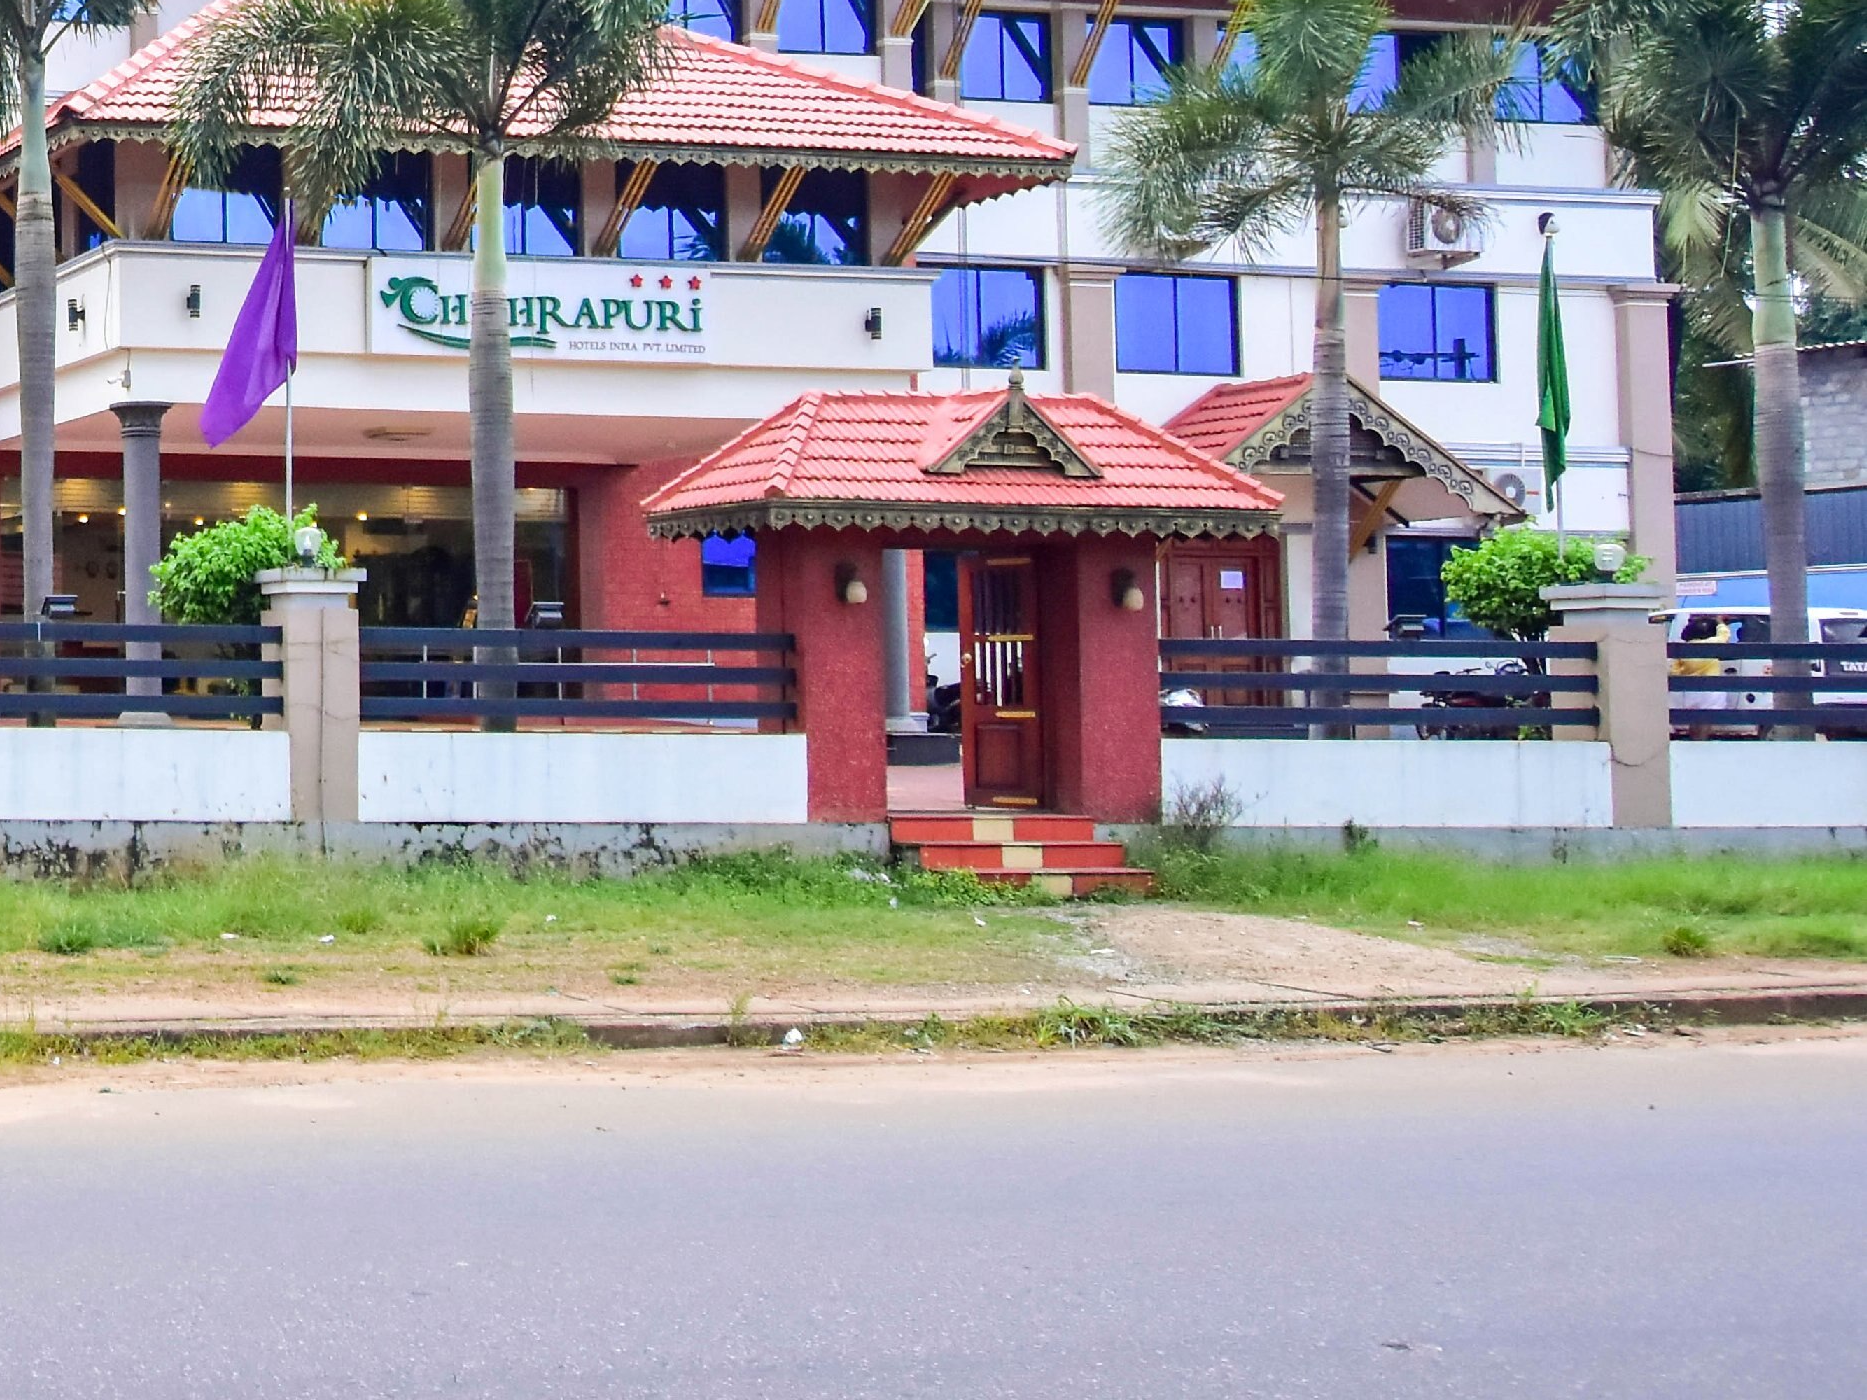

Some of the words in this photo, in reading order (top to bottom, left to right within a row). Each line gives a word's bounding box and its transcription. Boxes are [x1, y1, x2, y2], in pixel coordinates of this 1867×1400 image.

[381, 276, 703, 335] CHHRAPURi
[569, 341, 606, 351] HOTELS
[609, 342, 637, 352] INDIA
[665, 344, 706, 355] LIMITED
